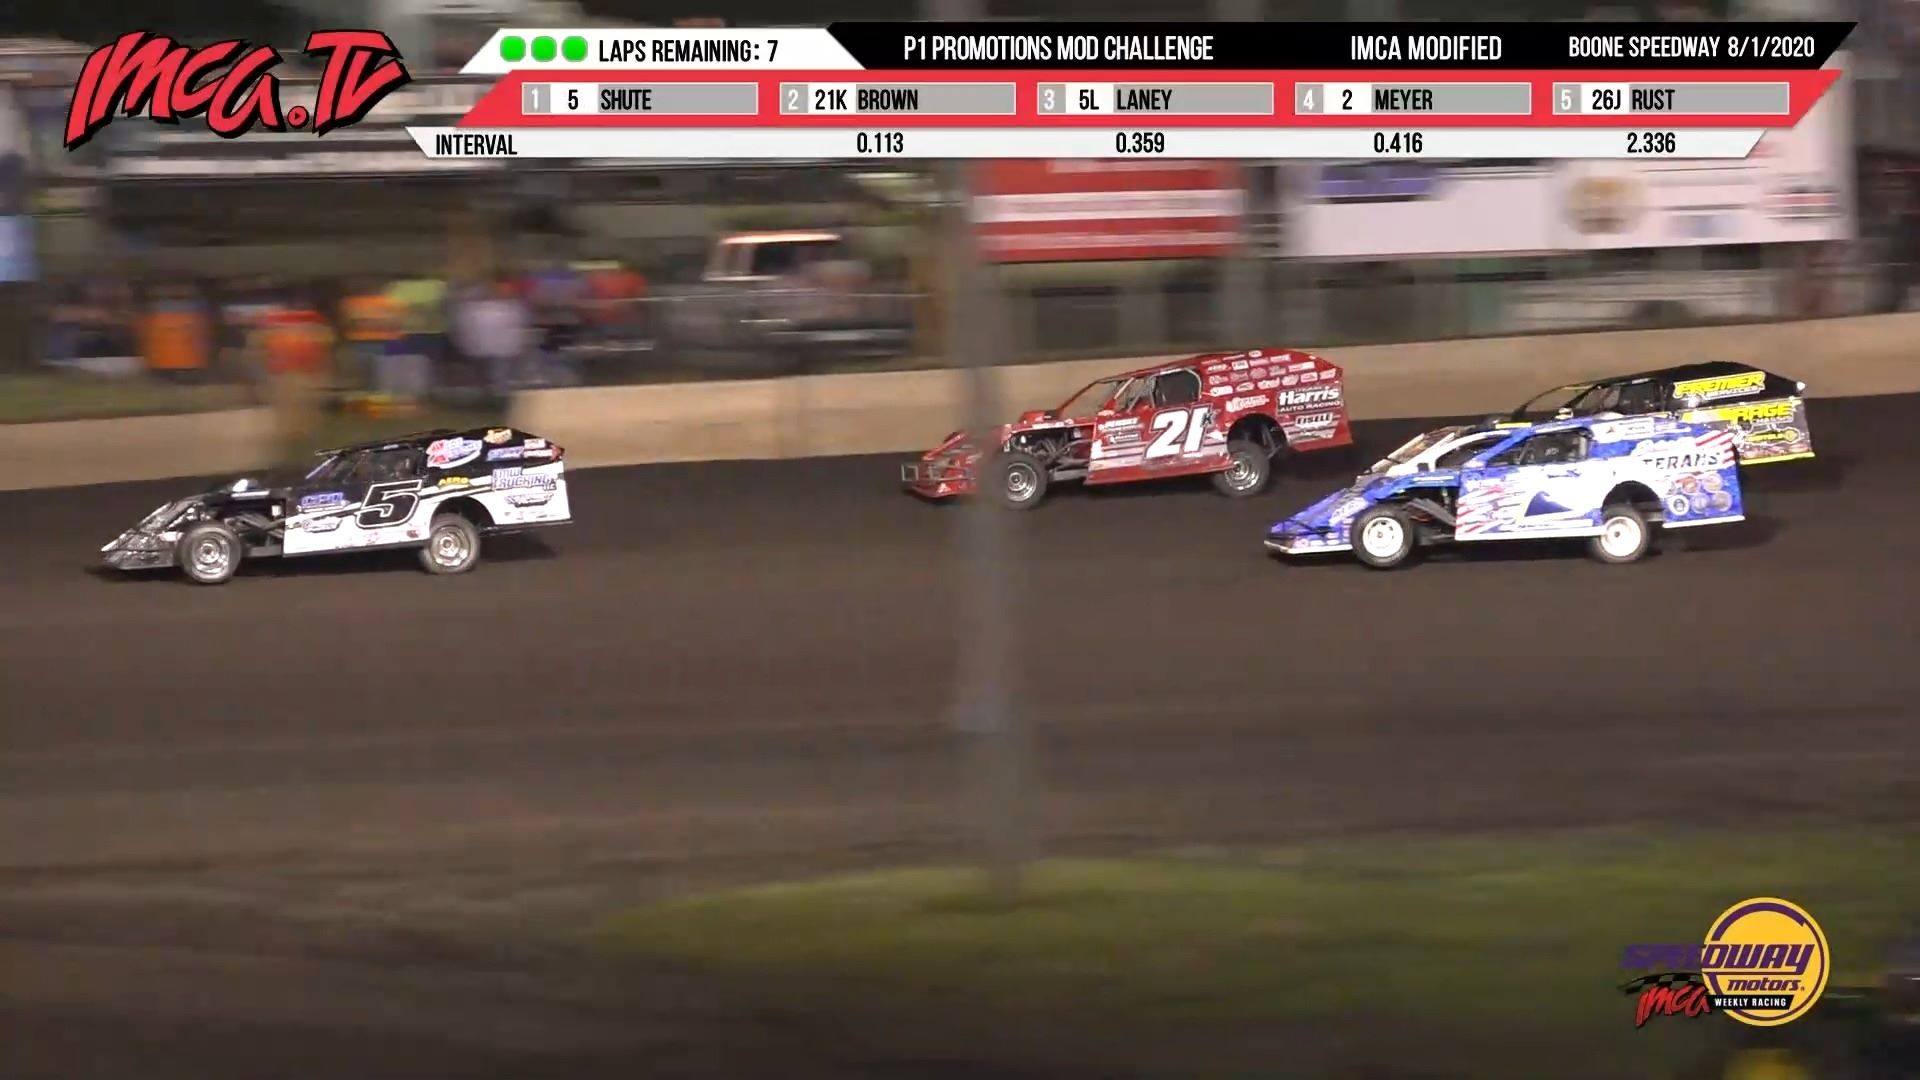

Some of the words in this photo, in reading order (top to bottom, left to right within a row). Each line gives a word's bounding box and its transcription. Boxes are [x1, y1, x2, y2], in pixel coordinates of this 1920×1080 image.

[1279, 385, 1339, 406] Harris
[1280, 404, 1305, 413] AUTO
[1305, 400, 1341, 409] RACING
[355, 479, 422, 530] 5
